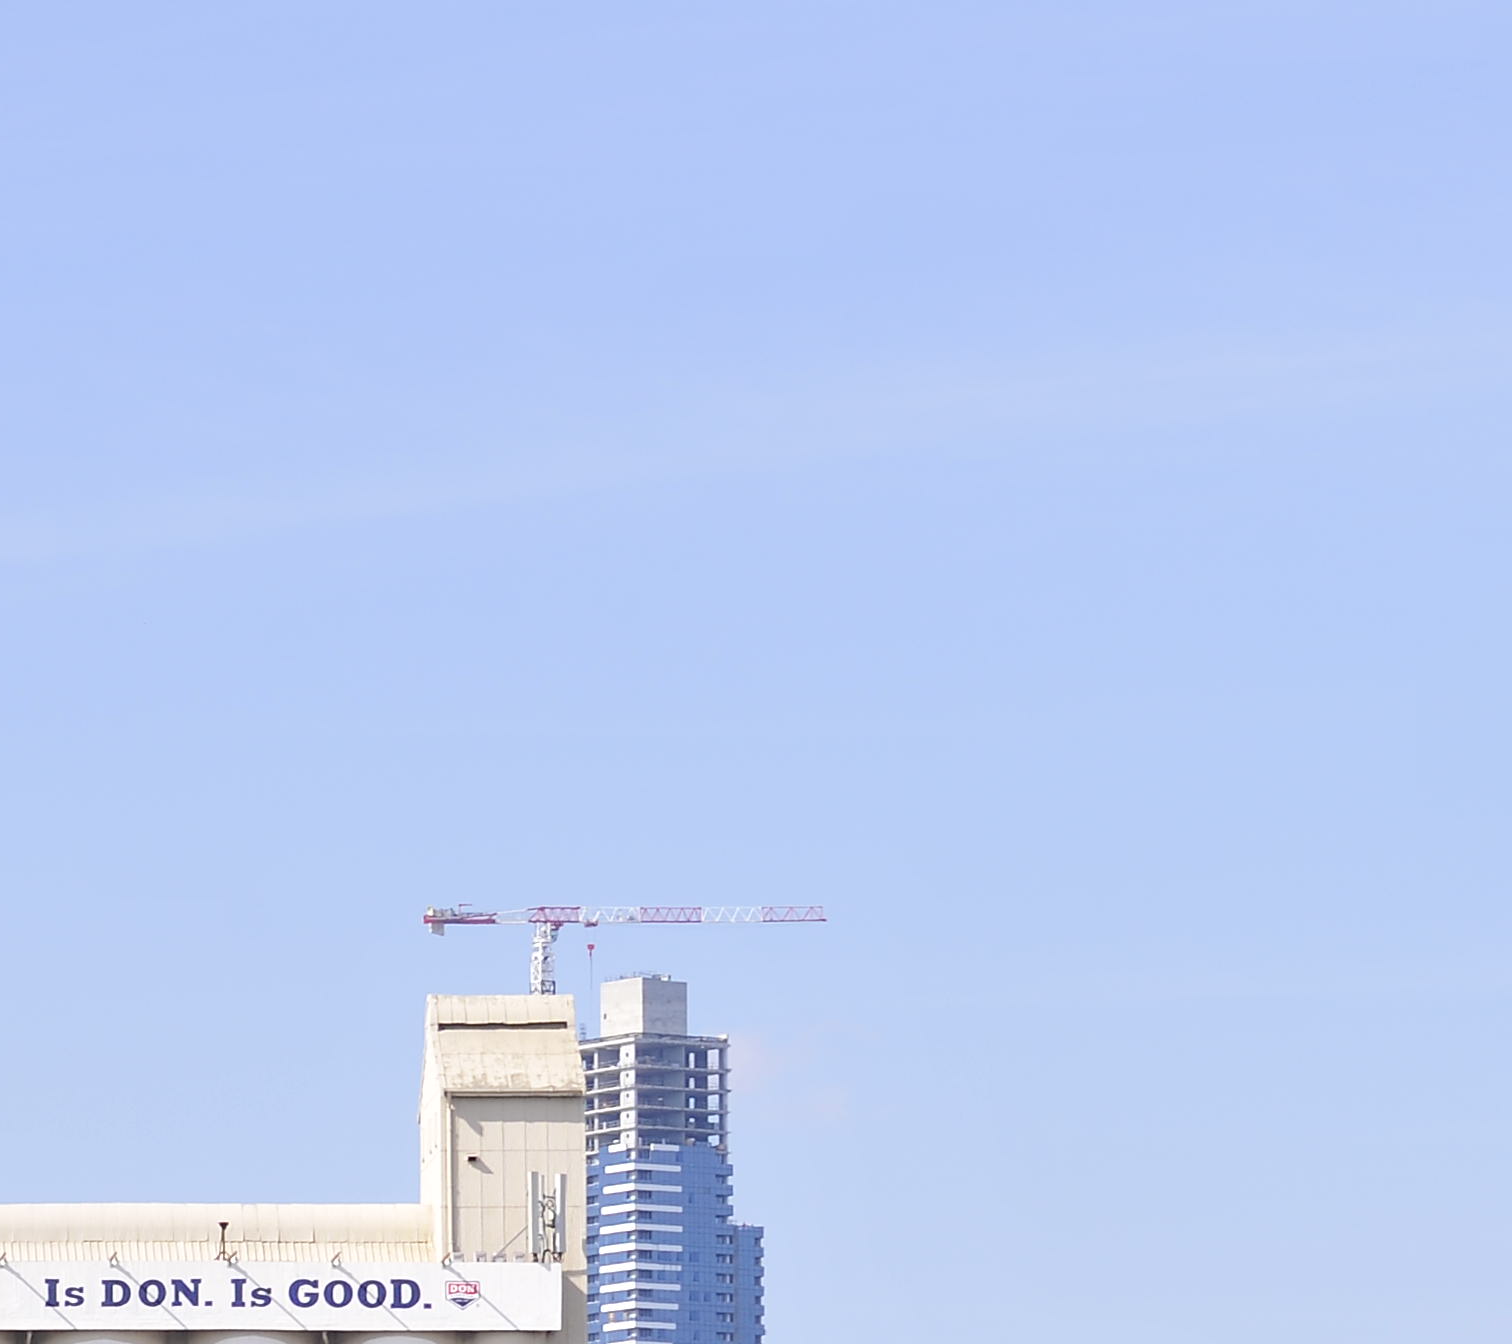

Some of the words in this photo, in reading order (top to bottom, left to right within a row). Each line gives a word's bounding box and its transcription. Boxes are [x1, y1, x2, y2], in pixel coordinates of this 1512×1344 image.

[45, 1279, 84, 1307] Is
[101, 1279, 213, 1307] DON.
[231, 1279, 272, 1307] Is
[288, 1279, 432, 1309] GOOD.
